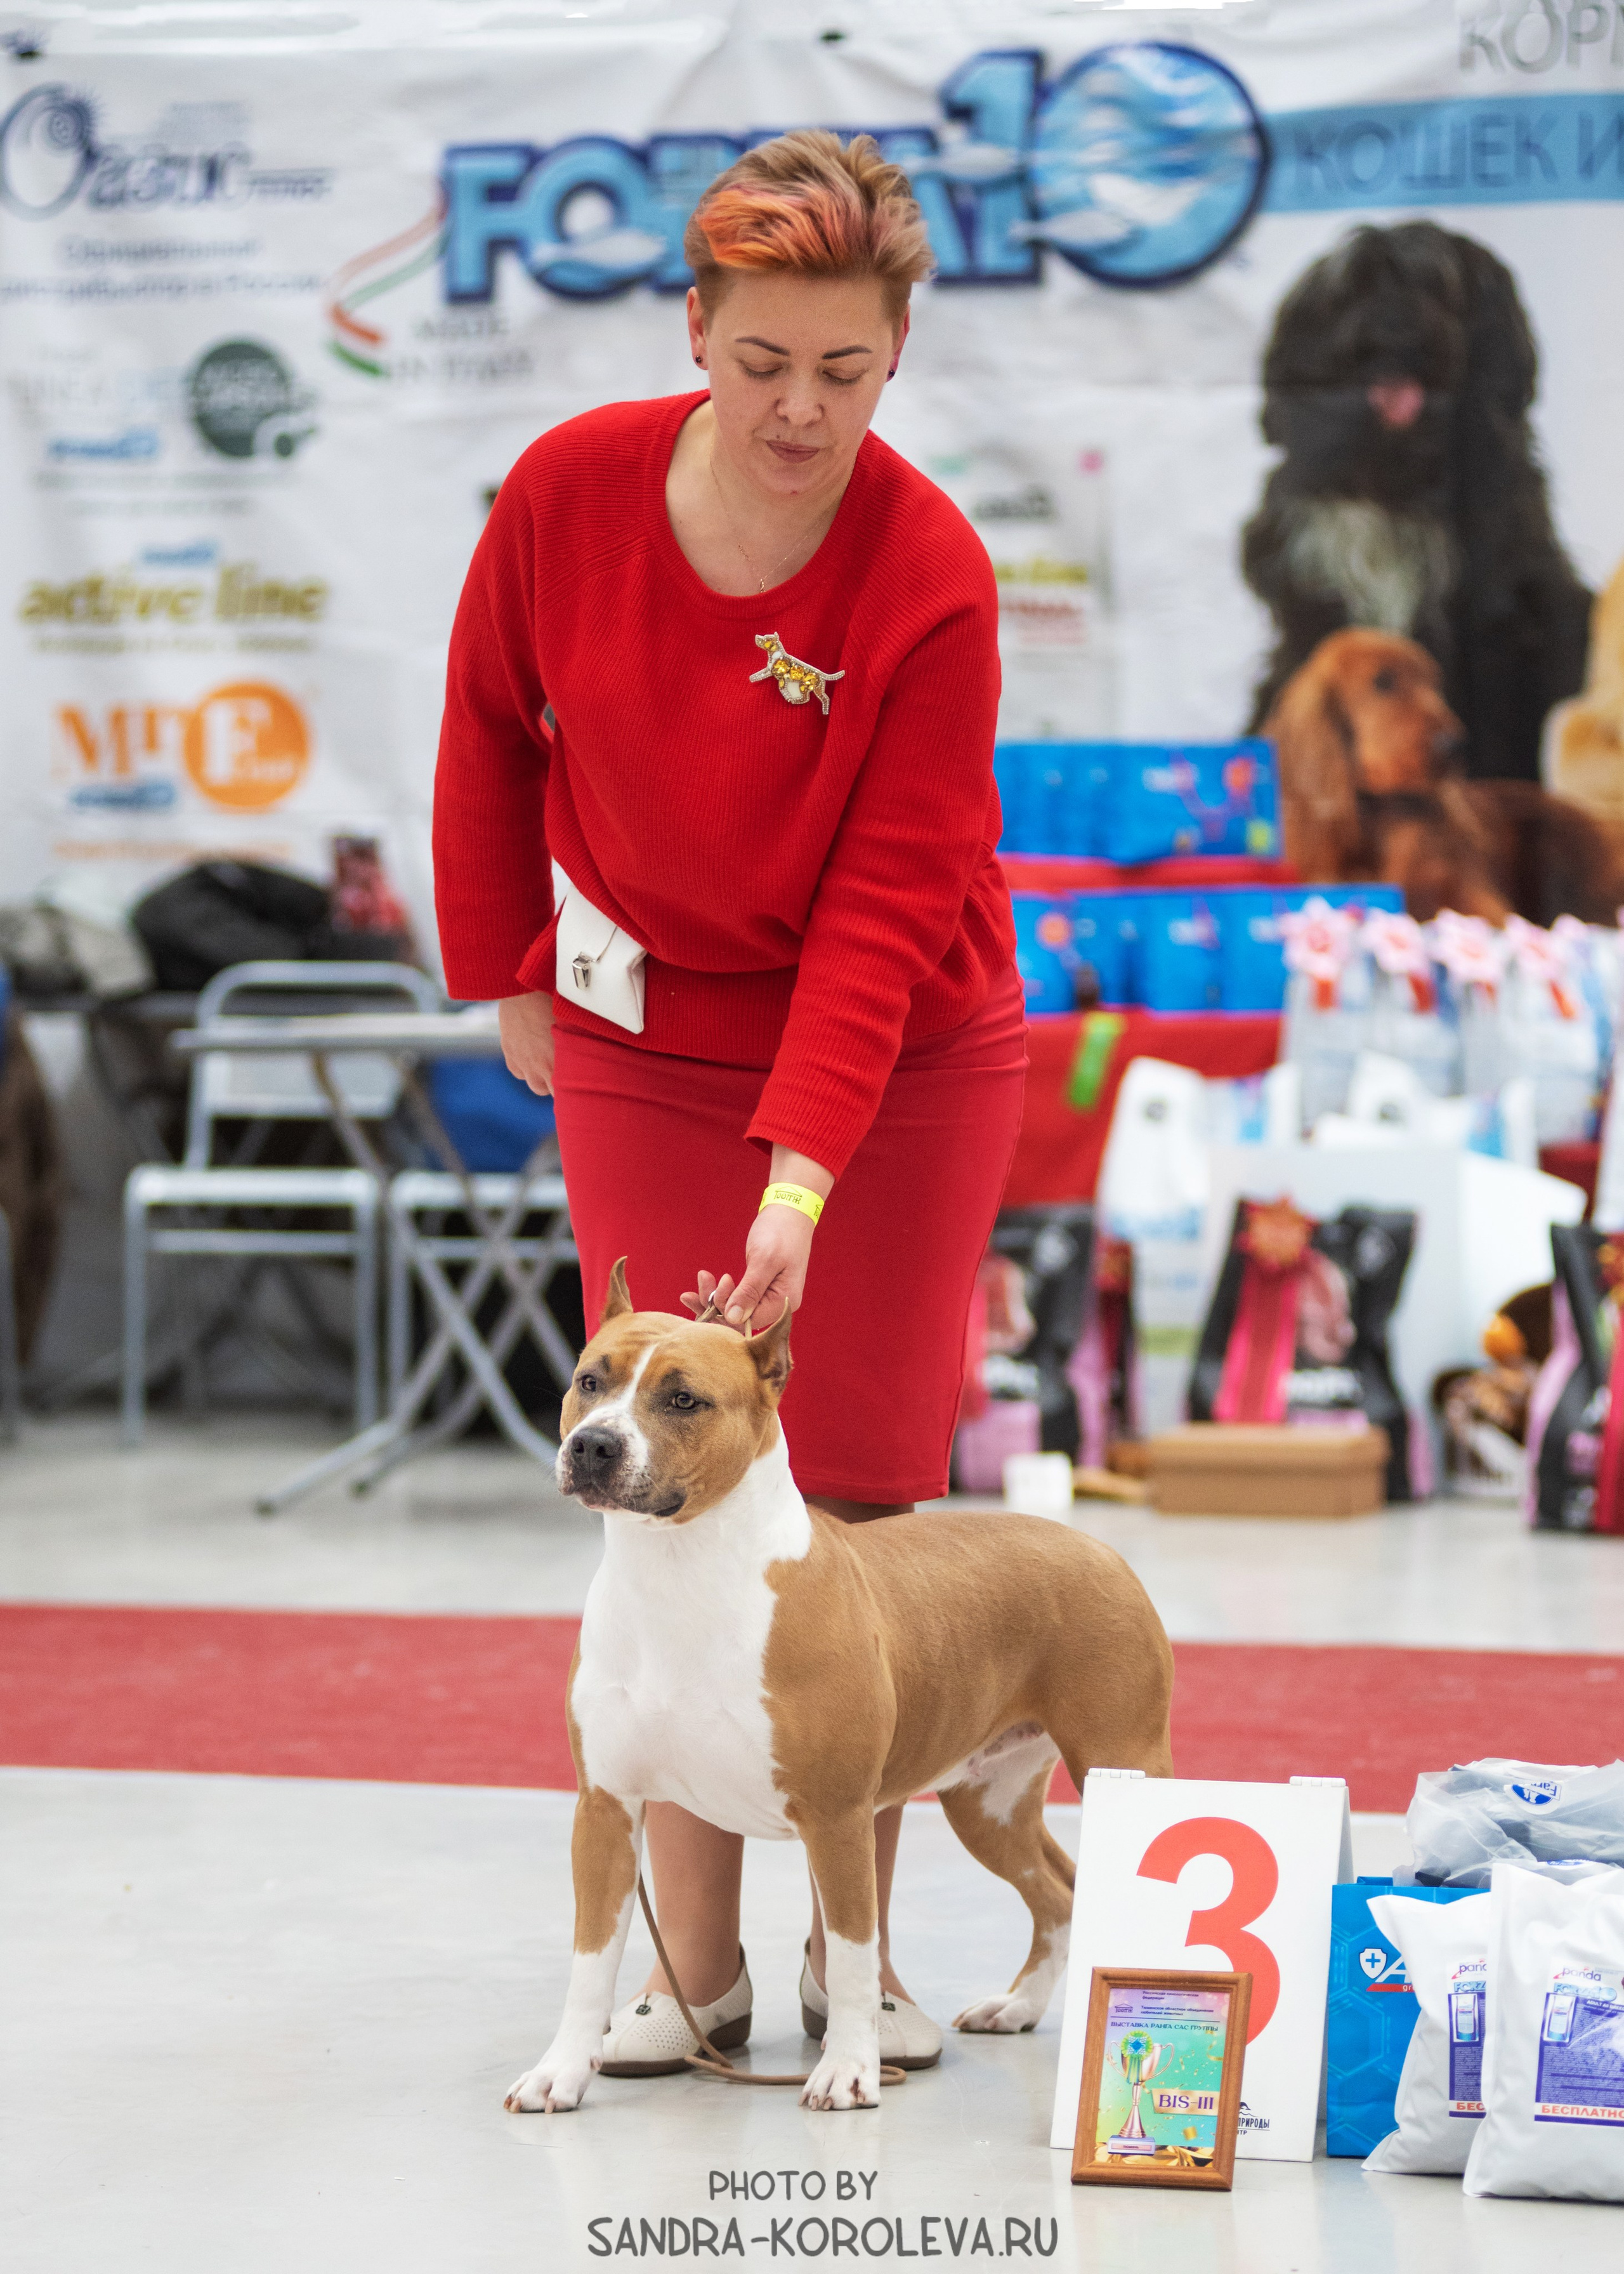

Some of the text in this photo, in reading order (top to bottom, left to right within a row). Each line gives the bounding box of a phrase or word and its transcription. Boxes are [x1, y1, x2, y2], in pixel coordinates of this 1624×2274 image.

[1292, 114, 1559, 194] КОШЕК
[1136, 1817, 1280, 2047] 3
[1562, 1968, 1602, 1982] panda
[1158, 2094, 1214, 2110] BIS-III
